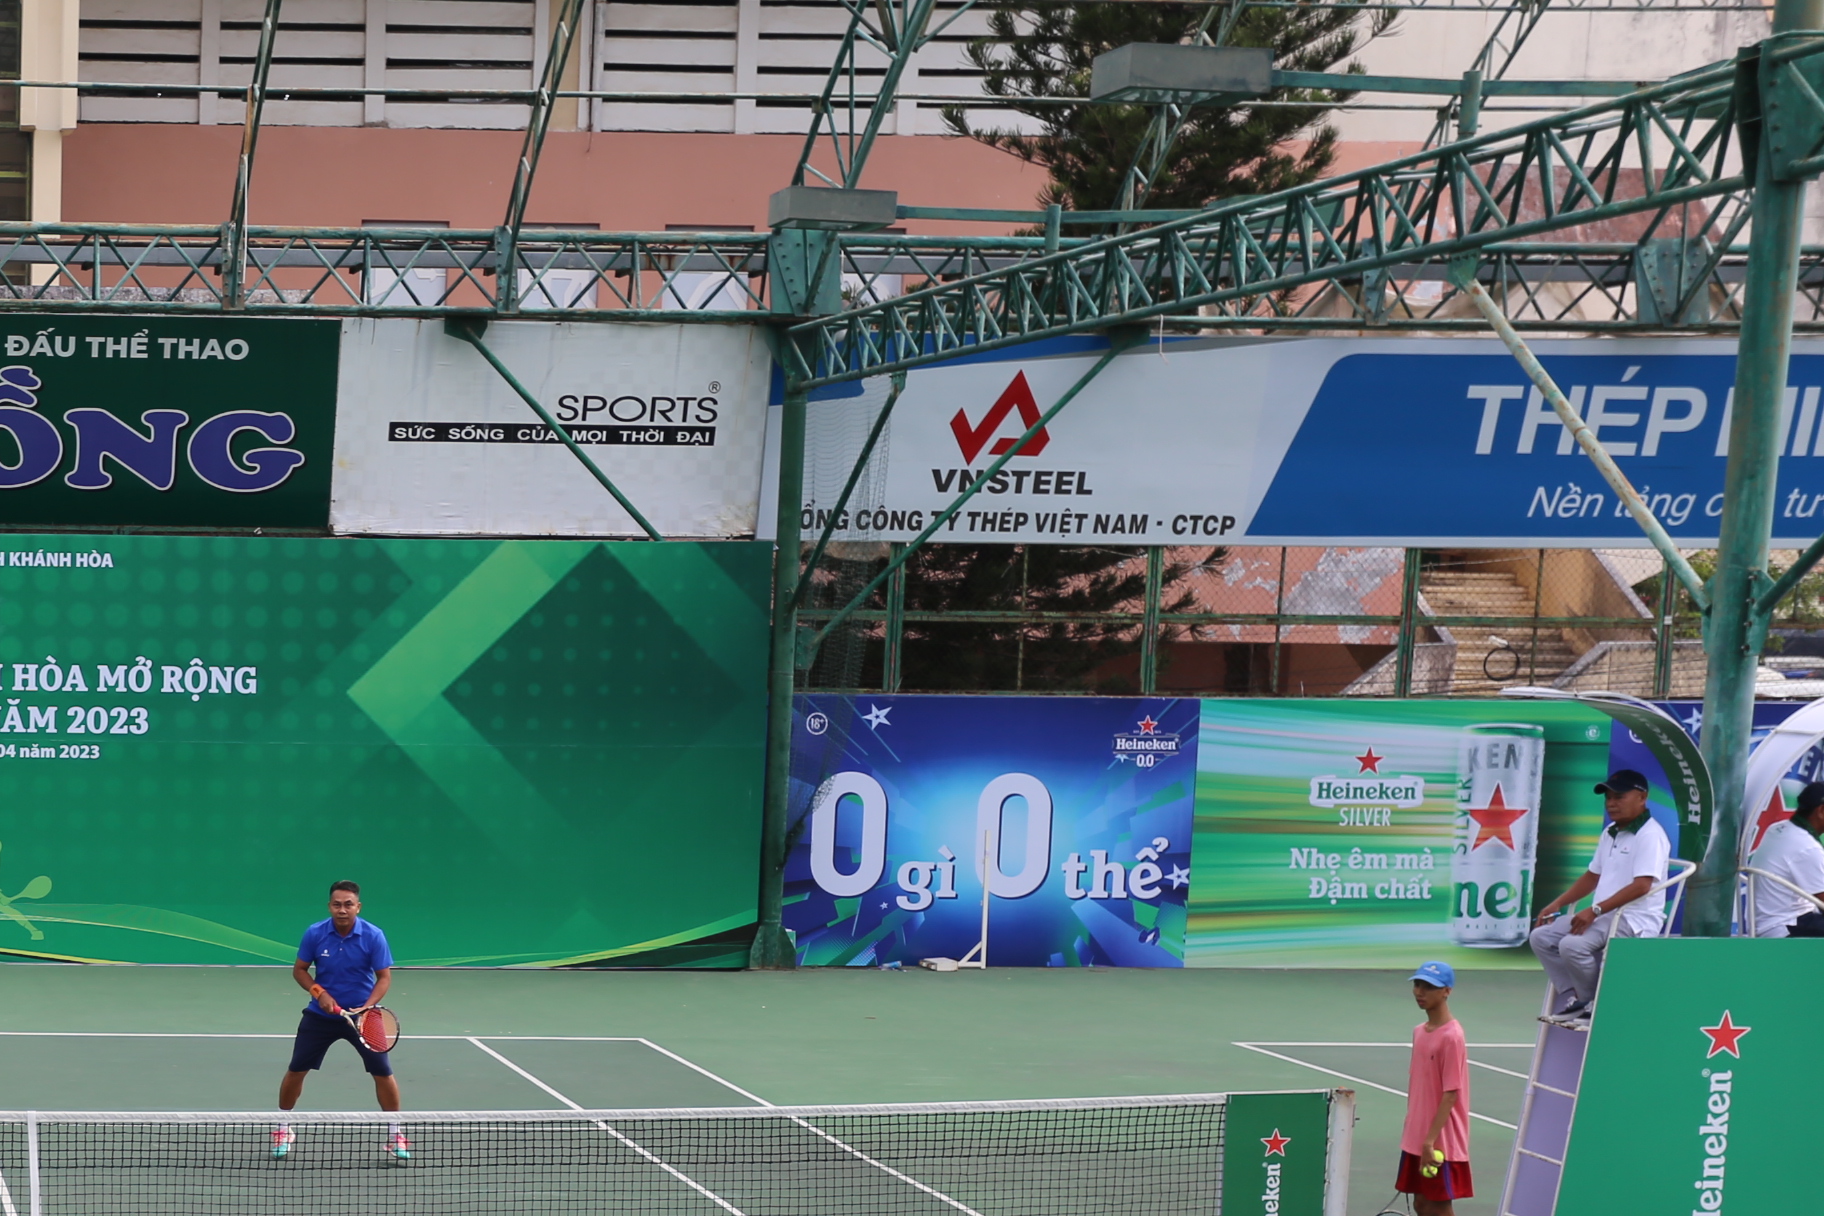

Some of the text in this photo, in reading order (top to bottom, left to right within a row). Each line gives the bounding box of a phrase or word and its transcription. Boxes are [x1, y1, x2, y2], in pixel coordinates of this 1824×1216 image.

[4, 327, 76, 358] ĐẤU
[85, 328, 148, 359] THỂ
[157, 337, 250, 361] THAO
[555, 394, 719, 423] SPORTS
[1466, 366, 1708, 457] THÉP
[394, 424, 710, 446] SỨC SỐNG CỦA MỌI THỜI ĐẠI
[931, 469, 1093, 495] VNSTEEL
[1527, 482, 1604, 518] Nền
[800, 499, 849, 531] ỔNG
[856, 504, 923, 531] CÔNG
[966, 507, 1029, 533] THÉP
[1034, 508, 1089, 538] VIỆT
[1092, 514, 1149, 535] NAM
[1171, 514, 1236, 536] CTCP
[9, 549, 72, 567] KHÁNH
[76, 550, 114, 568] HÒA
[11, 655, 89, 692] HÒA
[96, 655, 153, 693] MỞ
[160, 658, 258, 702] RỘNG
[66, 706, 150, 735] 2023
[19, 743, 56, 758] năm
[59, 744, 100, 759] 2023
[1116, 738, 1177, 751] Heineken
[1316, 781, 1417, 800] Heineken
[1339, 807, 1392, 827] SILVER
[895, 844, 957, 911] gì
[1061, 836, 1170, 900] thể
[1289, 847, 1434, 875] Nhẹ êm mà
[1308, 873, 1432, 905] Đậm chất
